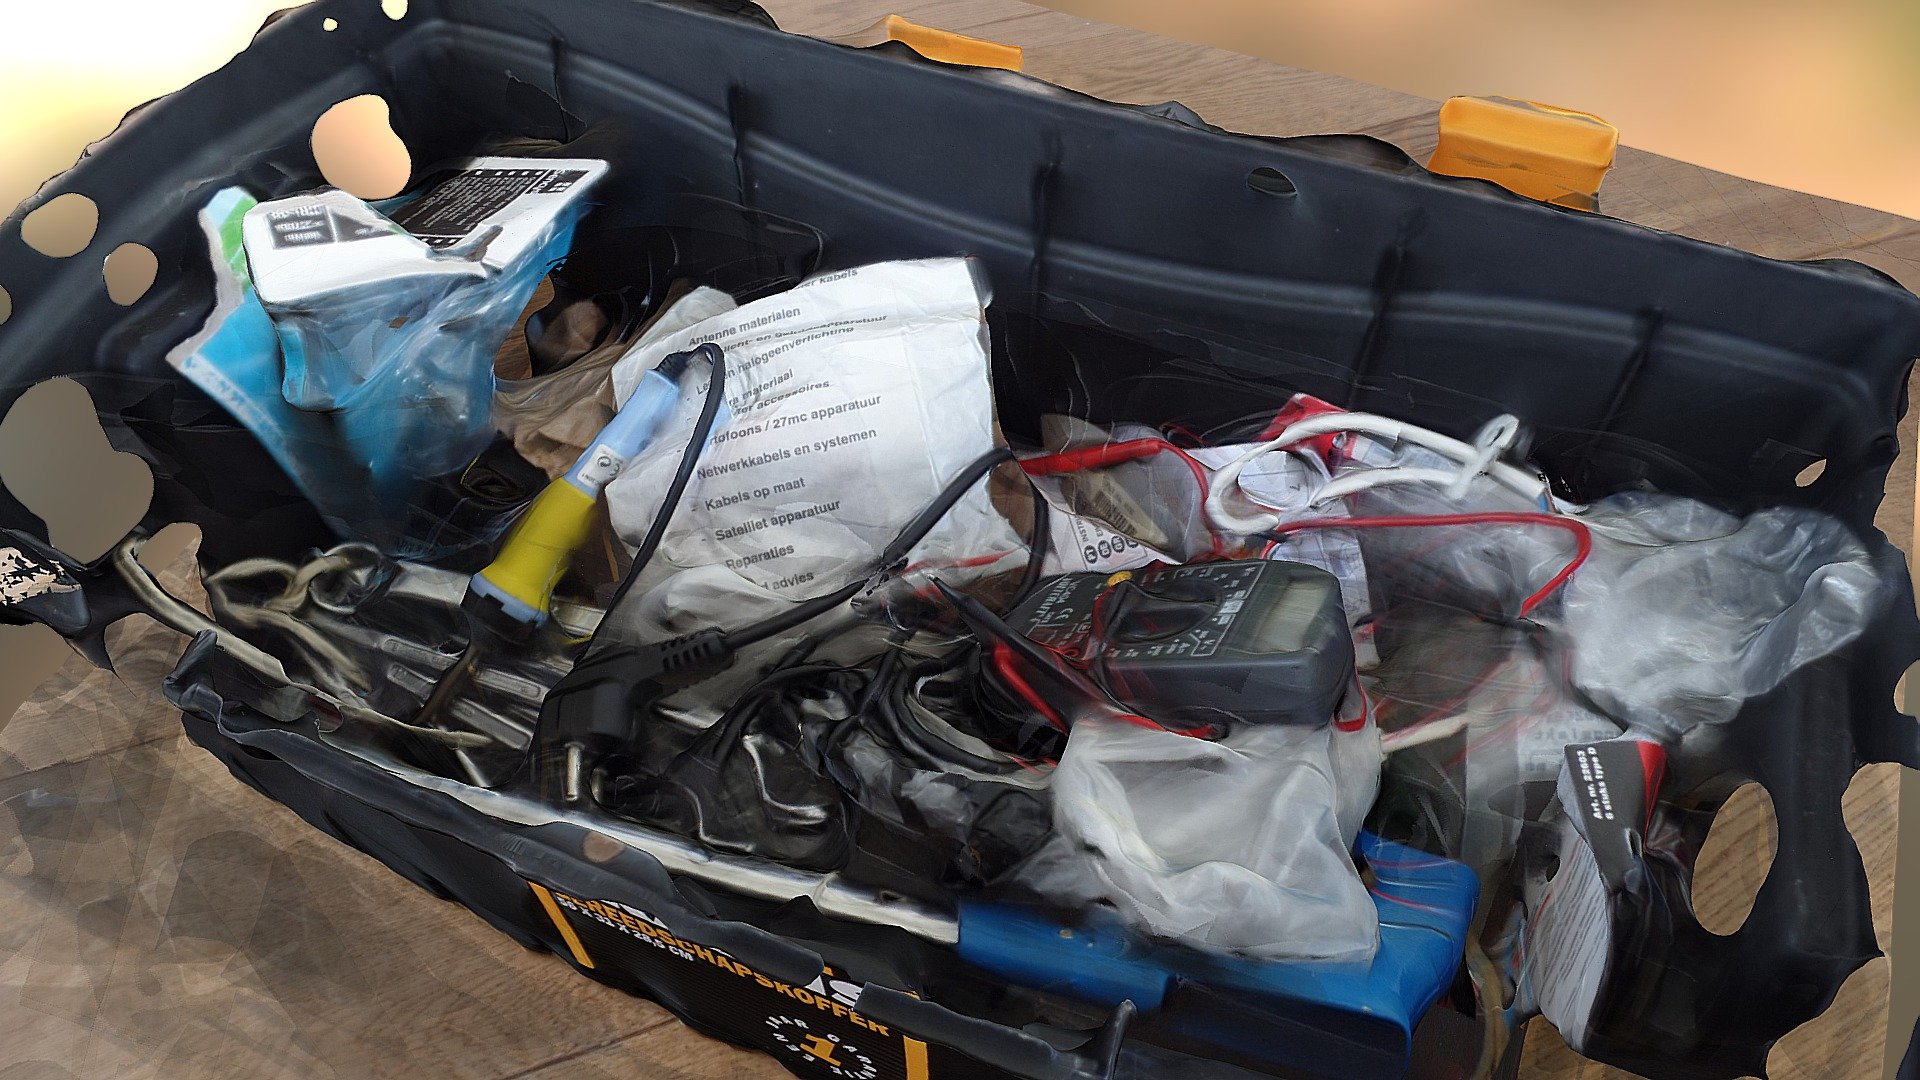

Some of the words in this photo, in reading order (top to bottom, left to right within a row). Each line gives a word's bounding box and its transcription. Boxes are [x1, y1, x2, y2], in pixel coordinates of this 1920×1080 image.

[688, 326, 737, 347] Antenne
[738, 307, 801, 333] materialen
[737, 327, 855, 374] halogeenverlichting
[742, 369, 794, 402] materiaal
[756, 381, 830, 410] accessoires
[709, 425, 762, 446] rtofoons
[773, 412, 808, 430] 27mc
[811, 395, 882, 420] apparatuur
[697, 448, 791, 480] Netwerkkabels
[794, 444, 810, 456] en
[814, 428, 877, 452] systemen
[705, 491, 751, 512] Kabels
[753, 487, 770, 500] op
[773, 477, 805, 494] maat
[715, 518, 769, 541] Satelliet
[770, 500, 841, 526] apparatuur
[725, 544, 795, 570] Reparaties
[772, 572, 815, 590] advies
[1592, 756, 1604, 780] type
[1598, 781, 1612, 811] stuks
[579, 906, 594, 918] X
[616, 922, 631, 934] X
[668, 945, 695, 962] CM
[765, 1015, 810, 1030] JAAR
[826, 1032, 878, 1080] GARANTIE
[800, 1033, 842, 1067] 1
